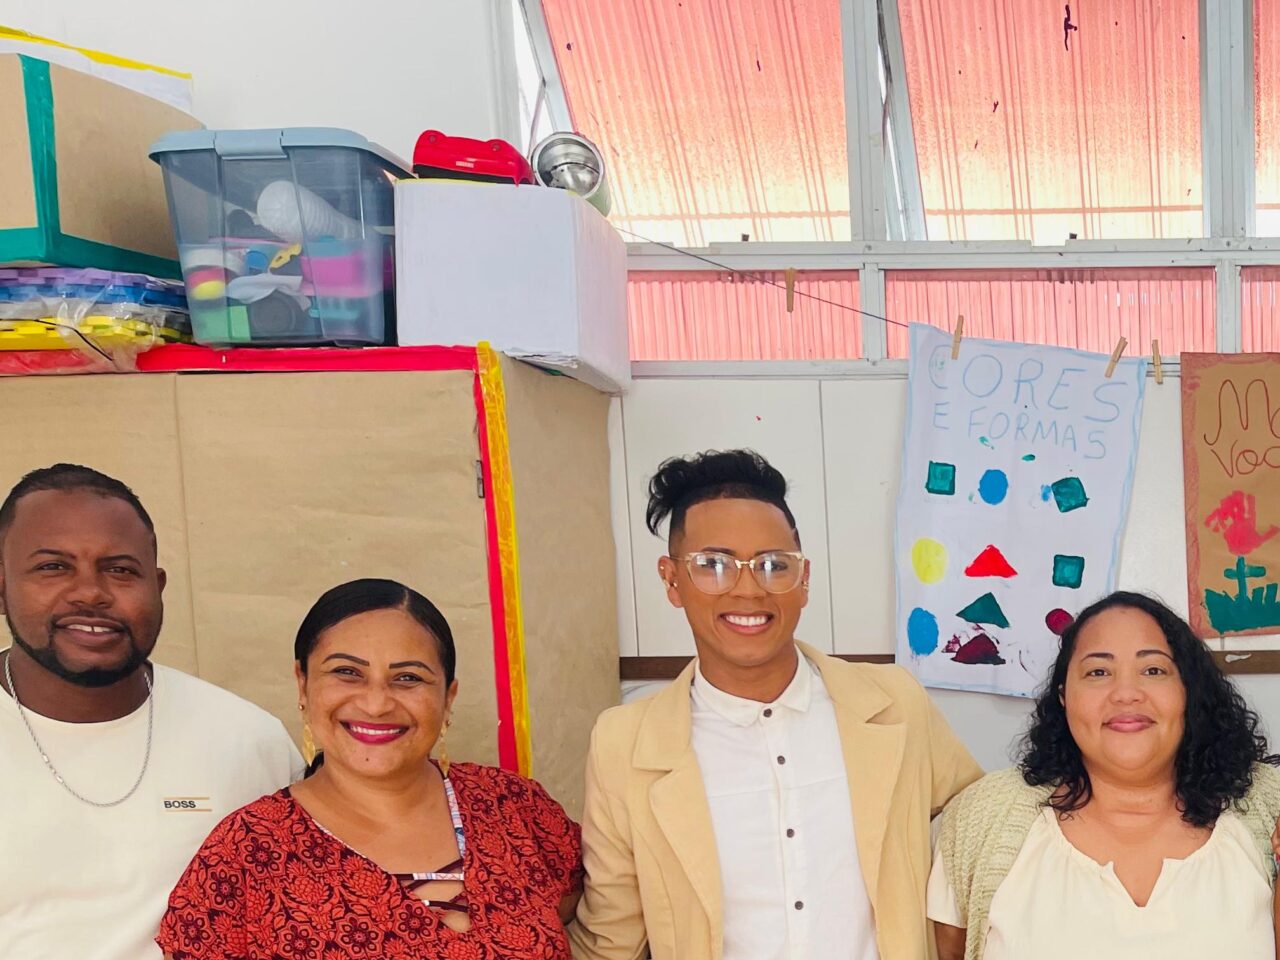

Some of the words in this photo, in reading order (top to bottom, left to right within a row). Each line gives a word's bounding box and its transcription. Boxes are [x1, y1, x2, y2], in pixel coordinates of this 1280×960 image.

[928, 344, 1127, 422] CORES
[932, 401, 950, 430] E
[967, 406, 1107, 459] FORMAS
[163, 800, 196, 809] BOSS
